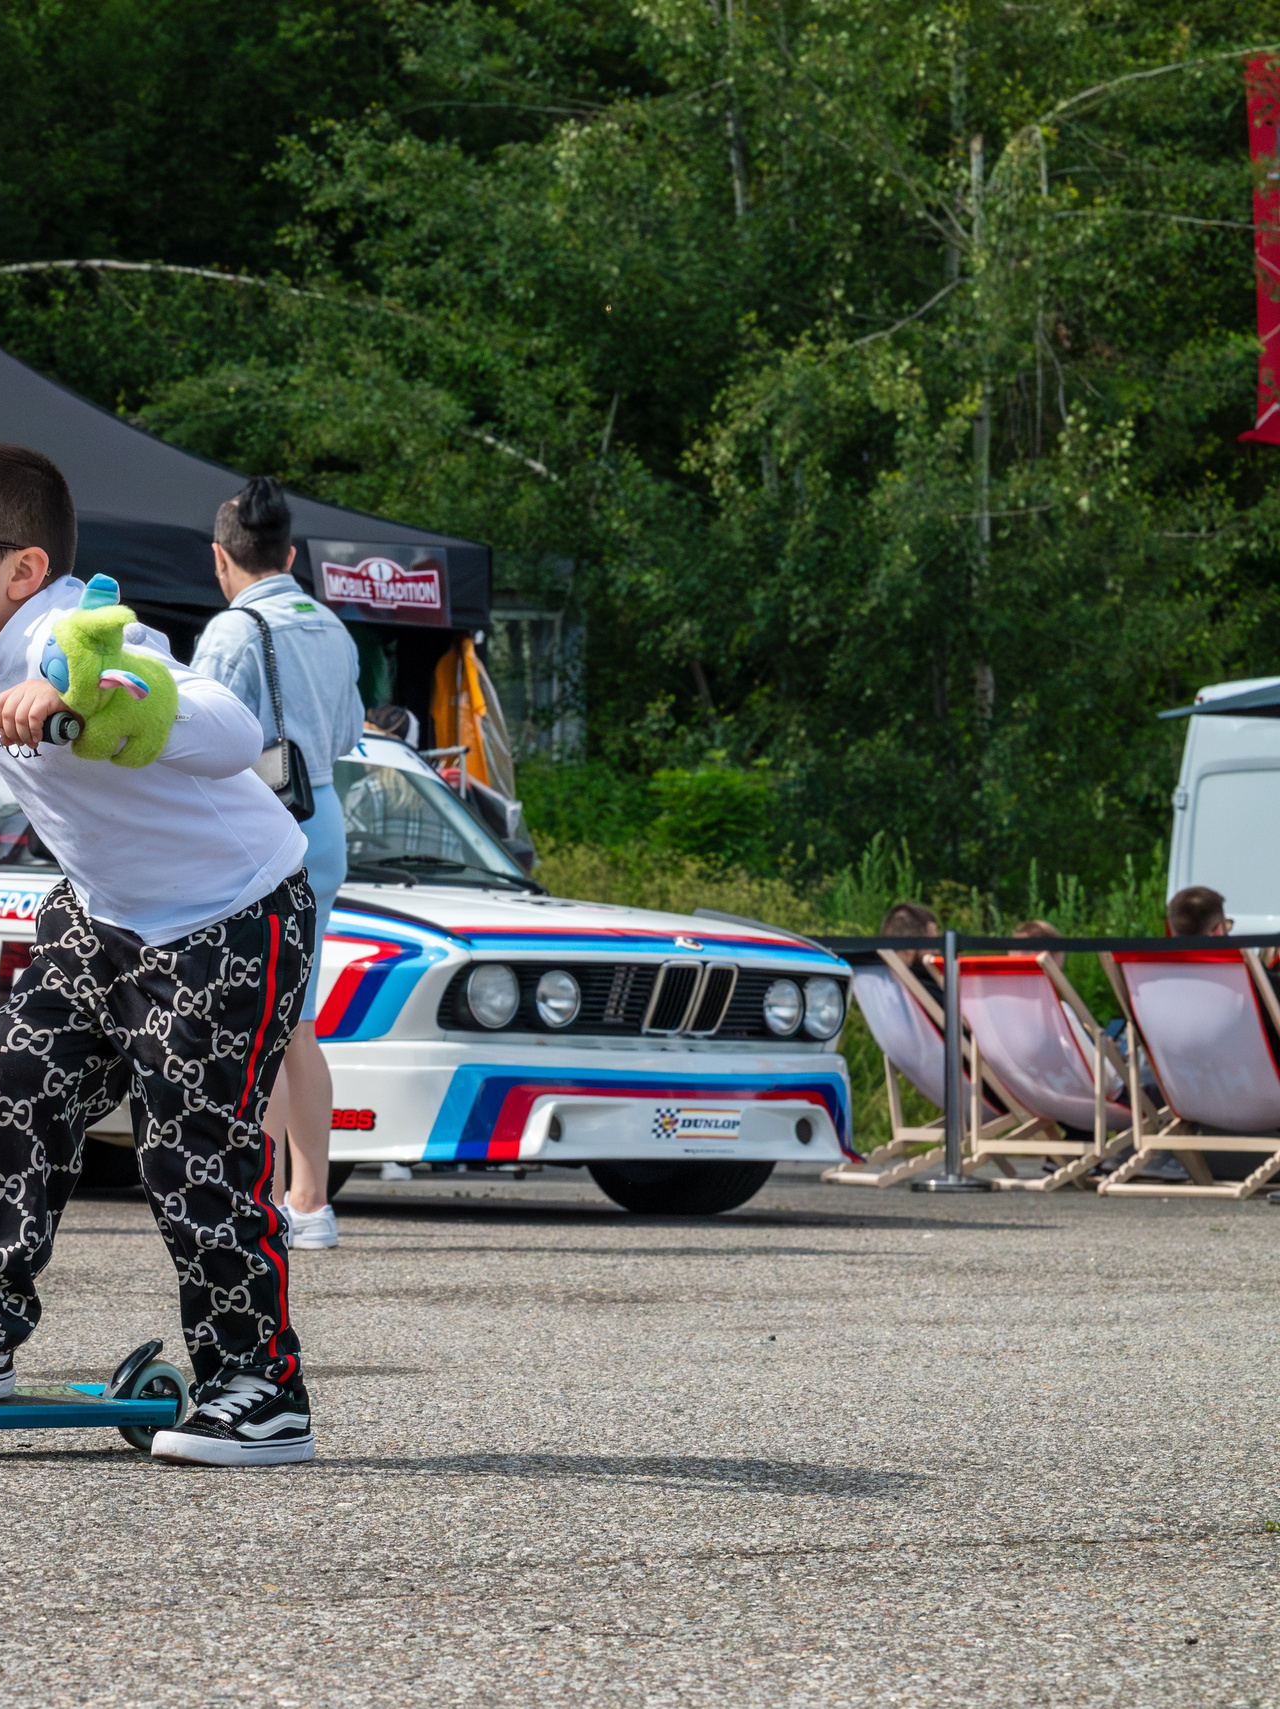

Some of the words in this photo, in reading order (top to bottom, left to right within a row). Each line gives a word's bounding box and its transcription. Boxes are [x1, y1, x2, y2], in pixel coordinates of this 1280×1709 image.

[328, 573, 373, 598] MOBILE
[373, 581, 437, 602] TRADITION
[681, 1118, 740, 1130] DUNLOP
